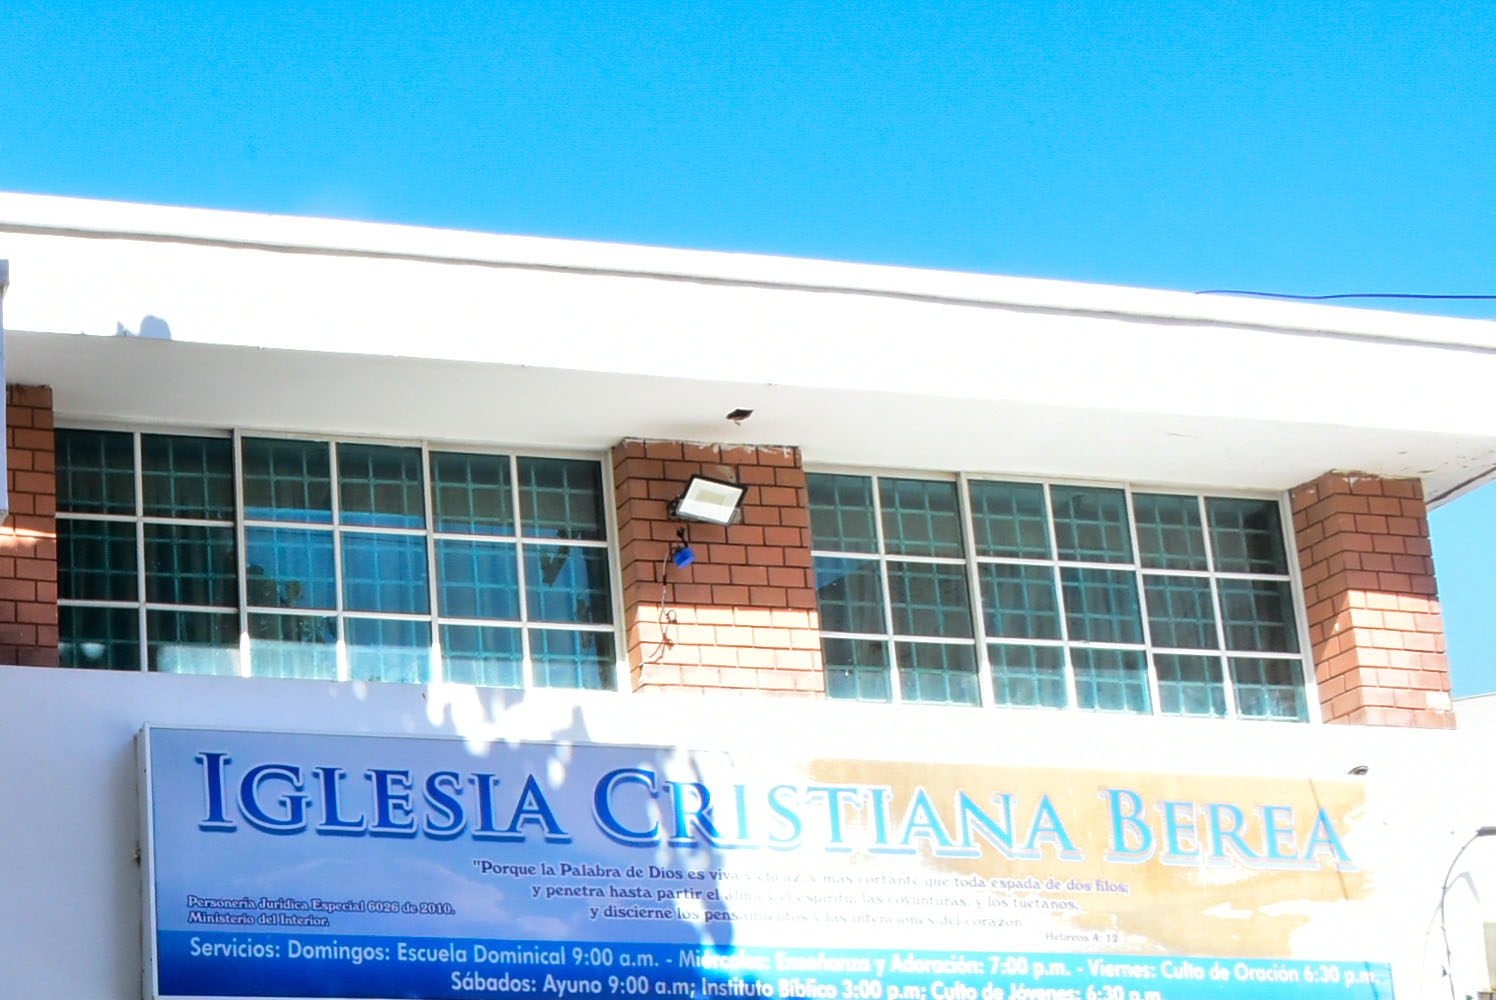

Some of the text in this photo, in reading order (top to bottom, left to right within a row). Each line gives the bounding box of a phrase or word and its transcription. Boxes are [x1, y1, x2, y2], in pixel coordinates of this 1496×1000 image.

[196, 749, 1361, 872] IGLESIA CRISTIANA BEREA
[541, 863, 555, 877] la
[560, 863, 622, 878] Palabra
[626, 865, 644, 878] de
[649, 865, 683, 880] Dios
[687, 868, 705, 880] es
[954, 876, 986, 888] toda
[991, 877, 1040, 891] espada
[1045, 879, 1062, 890] de
[1066, 879, 1091, 892] dos
[532, 885, 541, 898] y
[546, 885, 604, 899] penetra
[609, 885, 652, 898] hasta
[657, 888, 702, 901] partir
[706, 888, 720, 900] el
[311, 899, 365, 914] Especial
[367, 900, 399, 913] 6026
[402, 902, 418, 914] de
[419, 902, 455, 915] 2010.
[590, 907, 599, 919] y
[604, 906, 672, 920] discierne
[677, 907, 699, 920] los
[188, 911, 329, 927] Ministerio del Interior.
[190, 937, 280, 958] Servicios:
[288, 939, 390, 964] Domingos:
[397, 942, 467, 963] Escuela
[474, 944, 566, 965] Dominical
[573, 947, 613, 967] 9:00
[620, 950, 659, 967] a.m.
[874, 957, 886, 977] y
[890, 953, 984, 975] Adoración:
[989, 956, 1029, 976] 7:00
[1033, 961, 1072, 980] p.m.
[1087, 958, 1156, 978] Viernes:
[1161, 960, 1205, 980] Culto
[1209, 962, 1229, 981] de
[1234, 962, 1299, 982] Oración
[1304, 965, 1340, 984] 6:30
[1345, 968, 1380, 988] p.m.
[451, 971, 536, 992] Sábados:
[543, 974, 602, 998] Ayuno
[608, 976, 649, 995] 9:00
[656, 979, 696, 998] a.m;
[703, 977, 774, 998] Instituto
[841, 979, 882, 1000] 3:00
[930, 980, 977, 1000] Culto
[982, 982, 1004, 1000] de
